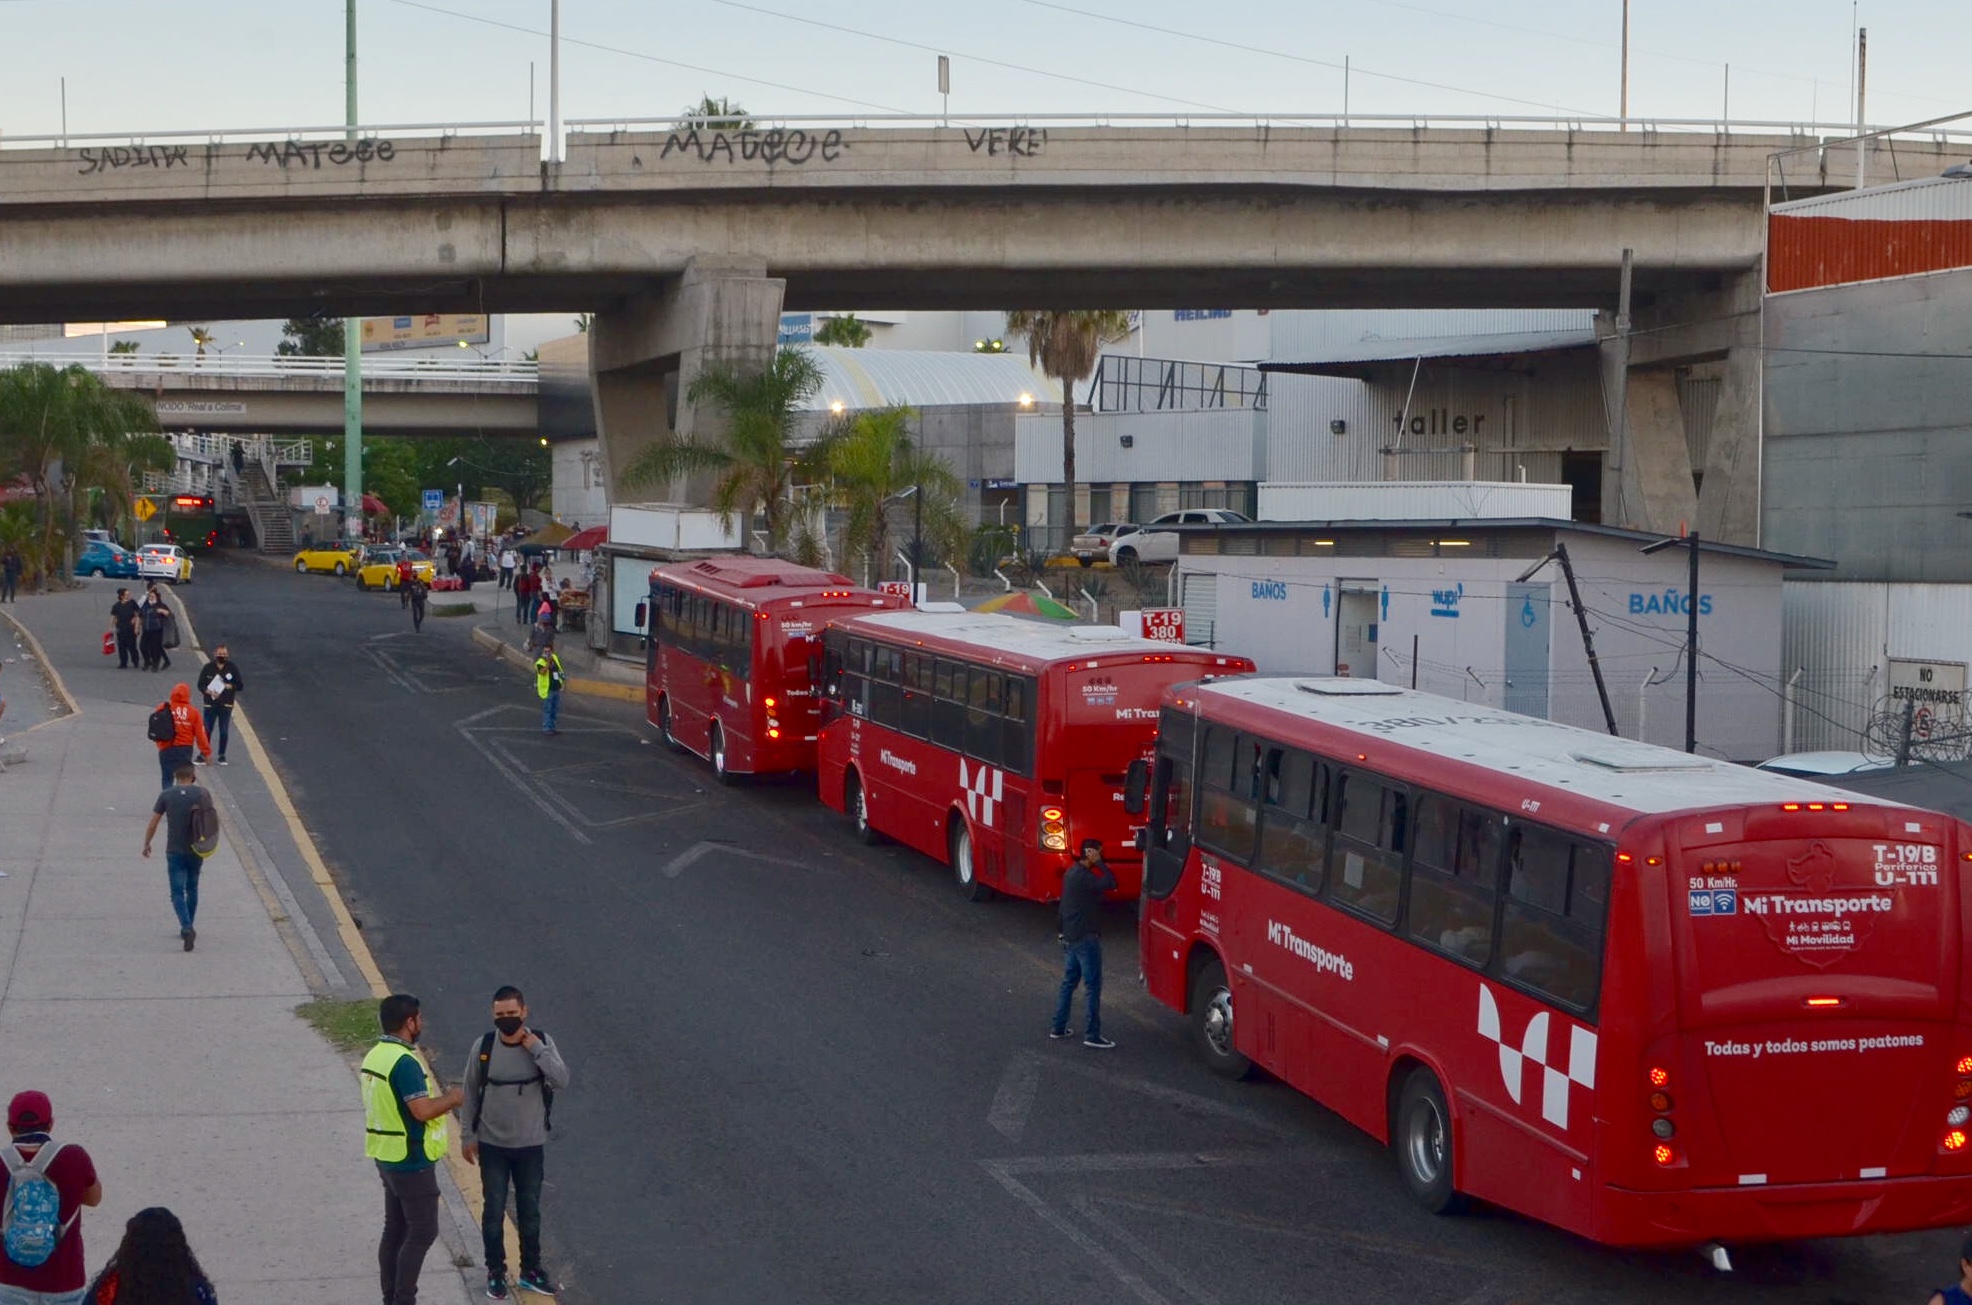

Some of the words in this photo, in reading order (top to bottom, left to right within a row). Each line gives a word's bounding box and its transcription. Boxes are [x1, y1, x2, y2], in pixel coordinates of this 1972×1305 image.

[1393, 409, 1485, 435] taller
[1629, 588, 1712, 615] BAÑOS
[1143, 612, 1182, 627] T-19
[1149, 625, 1177, 639] 380
[1919, 667, 1933, 682] NO
[1082, 685, 1093, 693] 50
[1893, 686, 1960, 704] ESTACIONARSE
[1116, 709, 1132, 719] Mi
[1873, 844, 1937, 863] T-19/B
[1689, 877, 1704, 889] 50
[1875, 871, 1938, 886] U-111
[1690, 895, 1711, 907] NO
[1744, 896, 1768, 914] Mi
[1770, 894, 1892, 918] Transporte
[1786, 936, 1799, 945] Mi
[1800, 933, 1855, 945] Movilidad
[1268, 918, 1281, 945] Mi
[1282, 924, 1354, 981] Transporte
[1705, 1041, 1750, 1056] Todas
[1752, 1042, 1763, 1058] y
[1765, 1038, 1808, 1054] todos
[1810, 1038, 1856, 1051] somos
[1858, 1034, 1924, 1053] peatones
